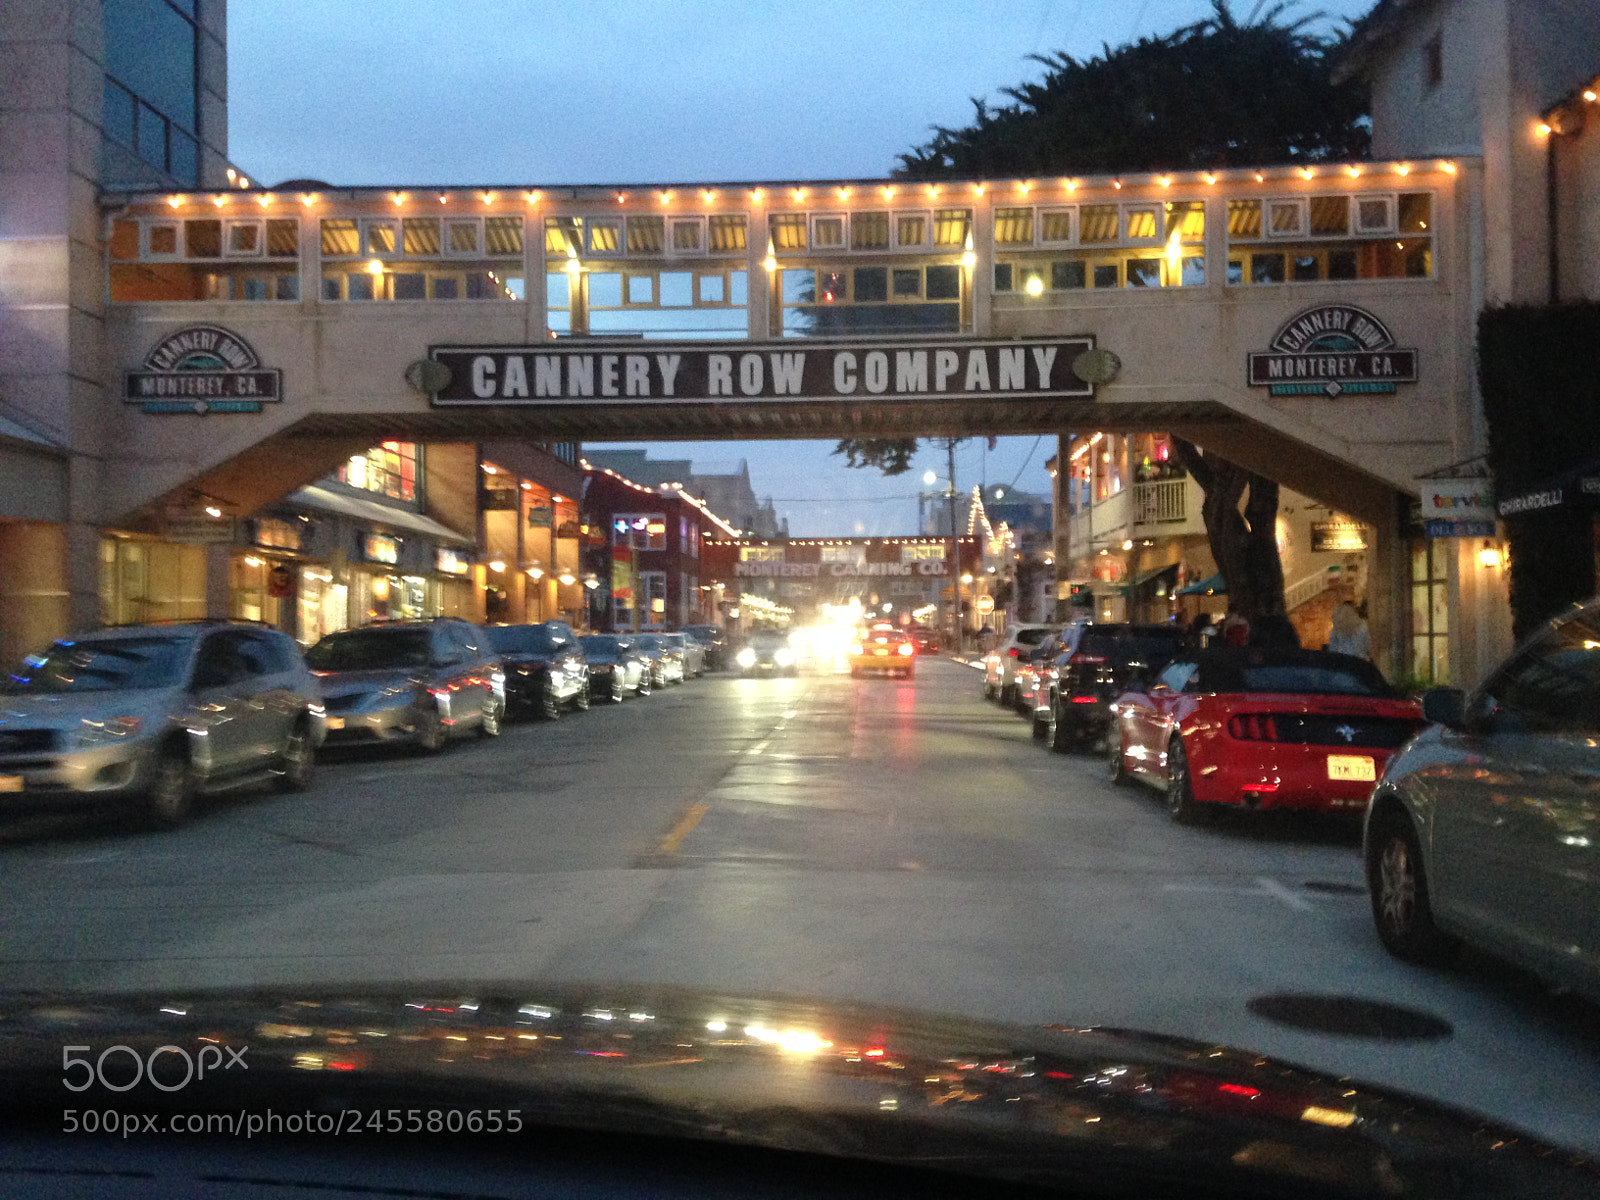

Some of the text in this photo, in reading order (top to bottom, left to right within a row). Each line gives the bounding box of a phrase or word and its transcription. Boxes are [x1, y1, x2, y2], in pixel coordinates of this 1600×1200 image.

[1283, 310, 1386, 350] CANNERY ROW
[153, 332, 218, 369] CANNERY
[472, 347, 1058, 398] CANNERY ROW COMPANY
[735, 561, 948, 577] MONTEREY CANNING CO.
